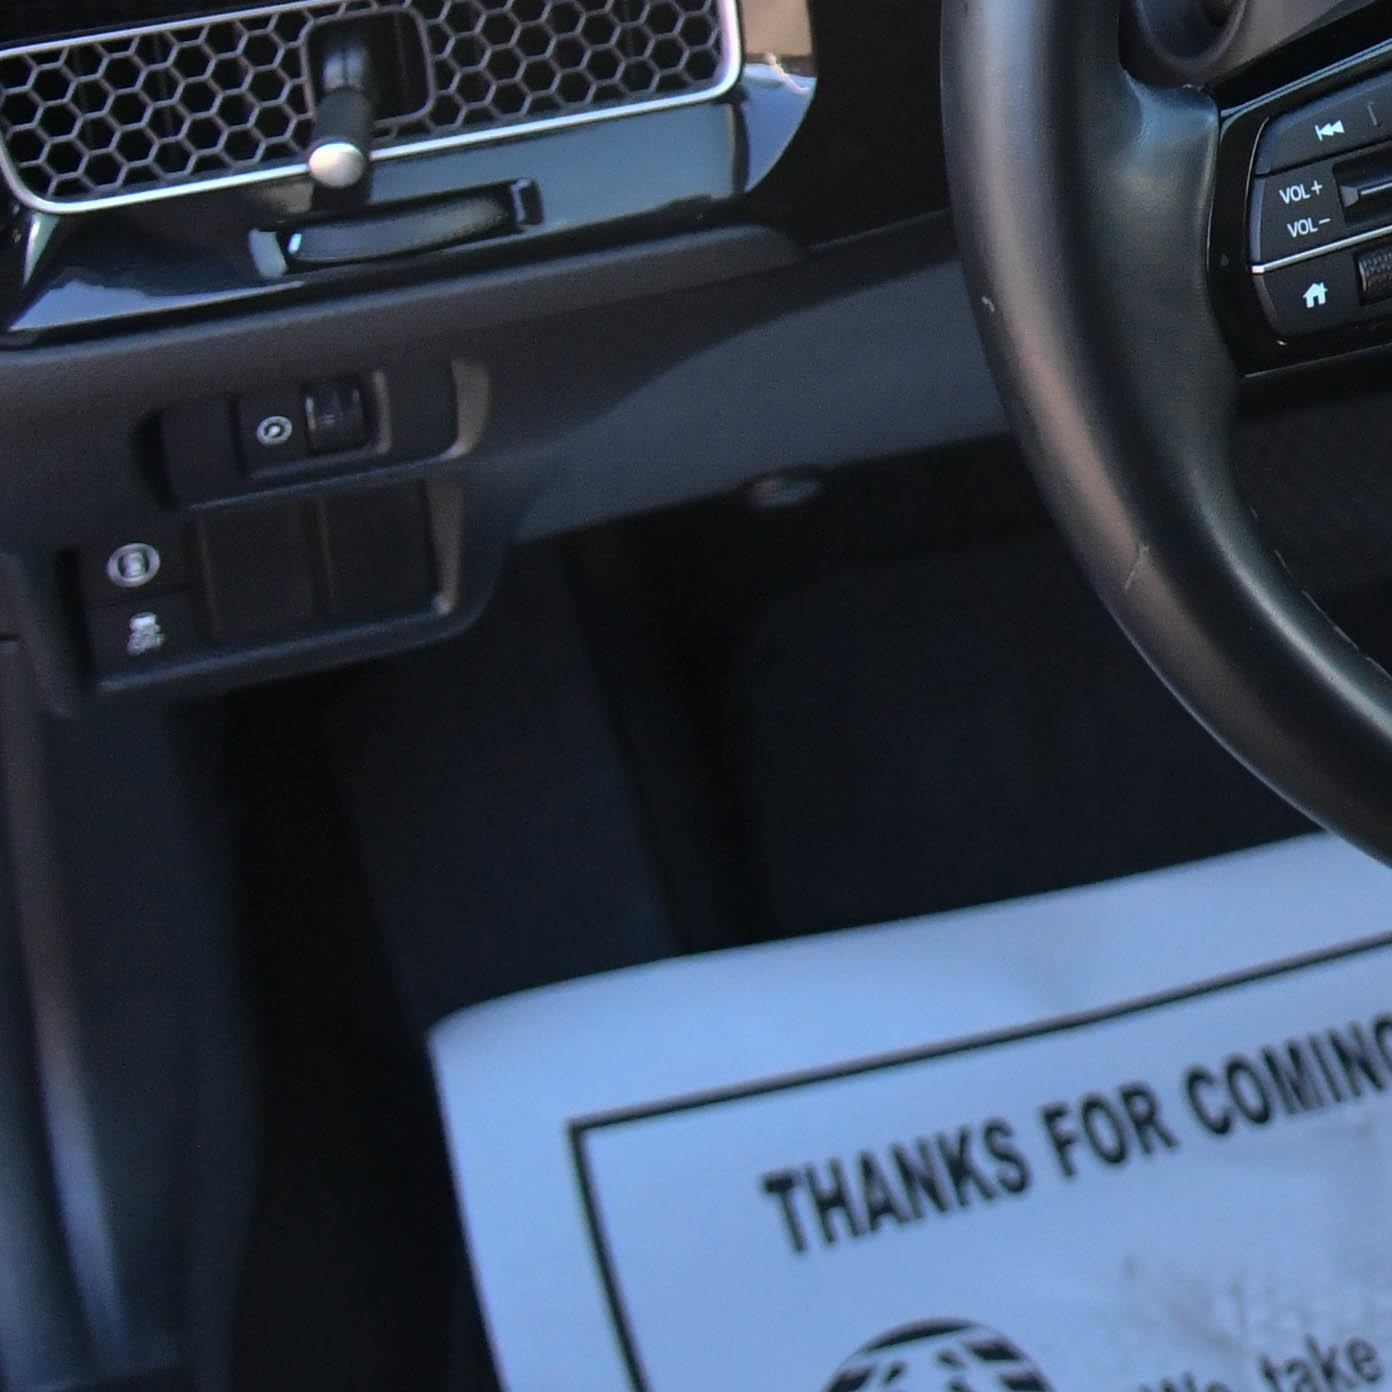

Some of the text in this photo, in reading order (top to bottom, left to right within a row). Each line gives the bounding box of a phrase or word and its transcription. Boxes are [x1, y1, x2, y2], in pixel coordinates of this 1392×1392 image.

[761, 1115, 1033, 1255] THANKS
[1040, 1078, 1181, 1179] FOR
[1257, 1332, 1385, 1392] take
